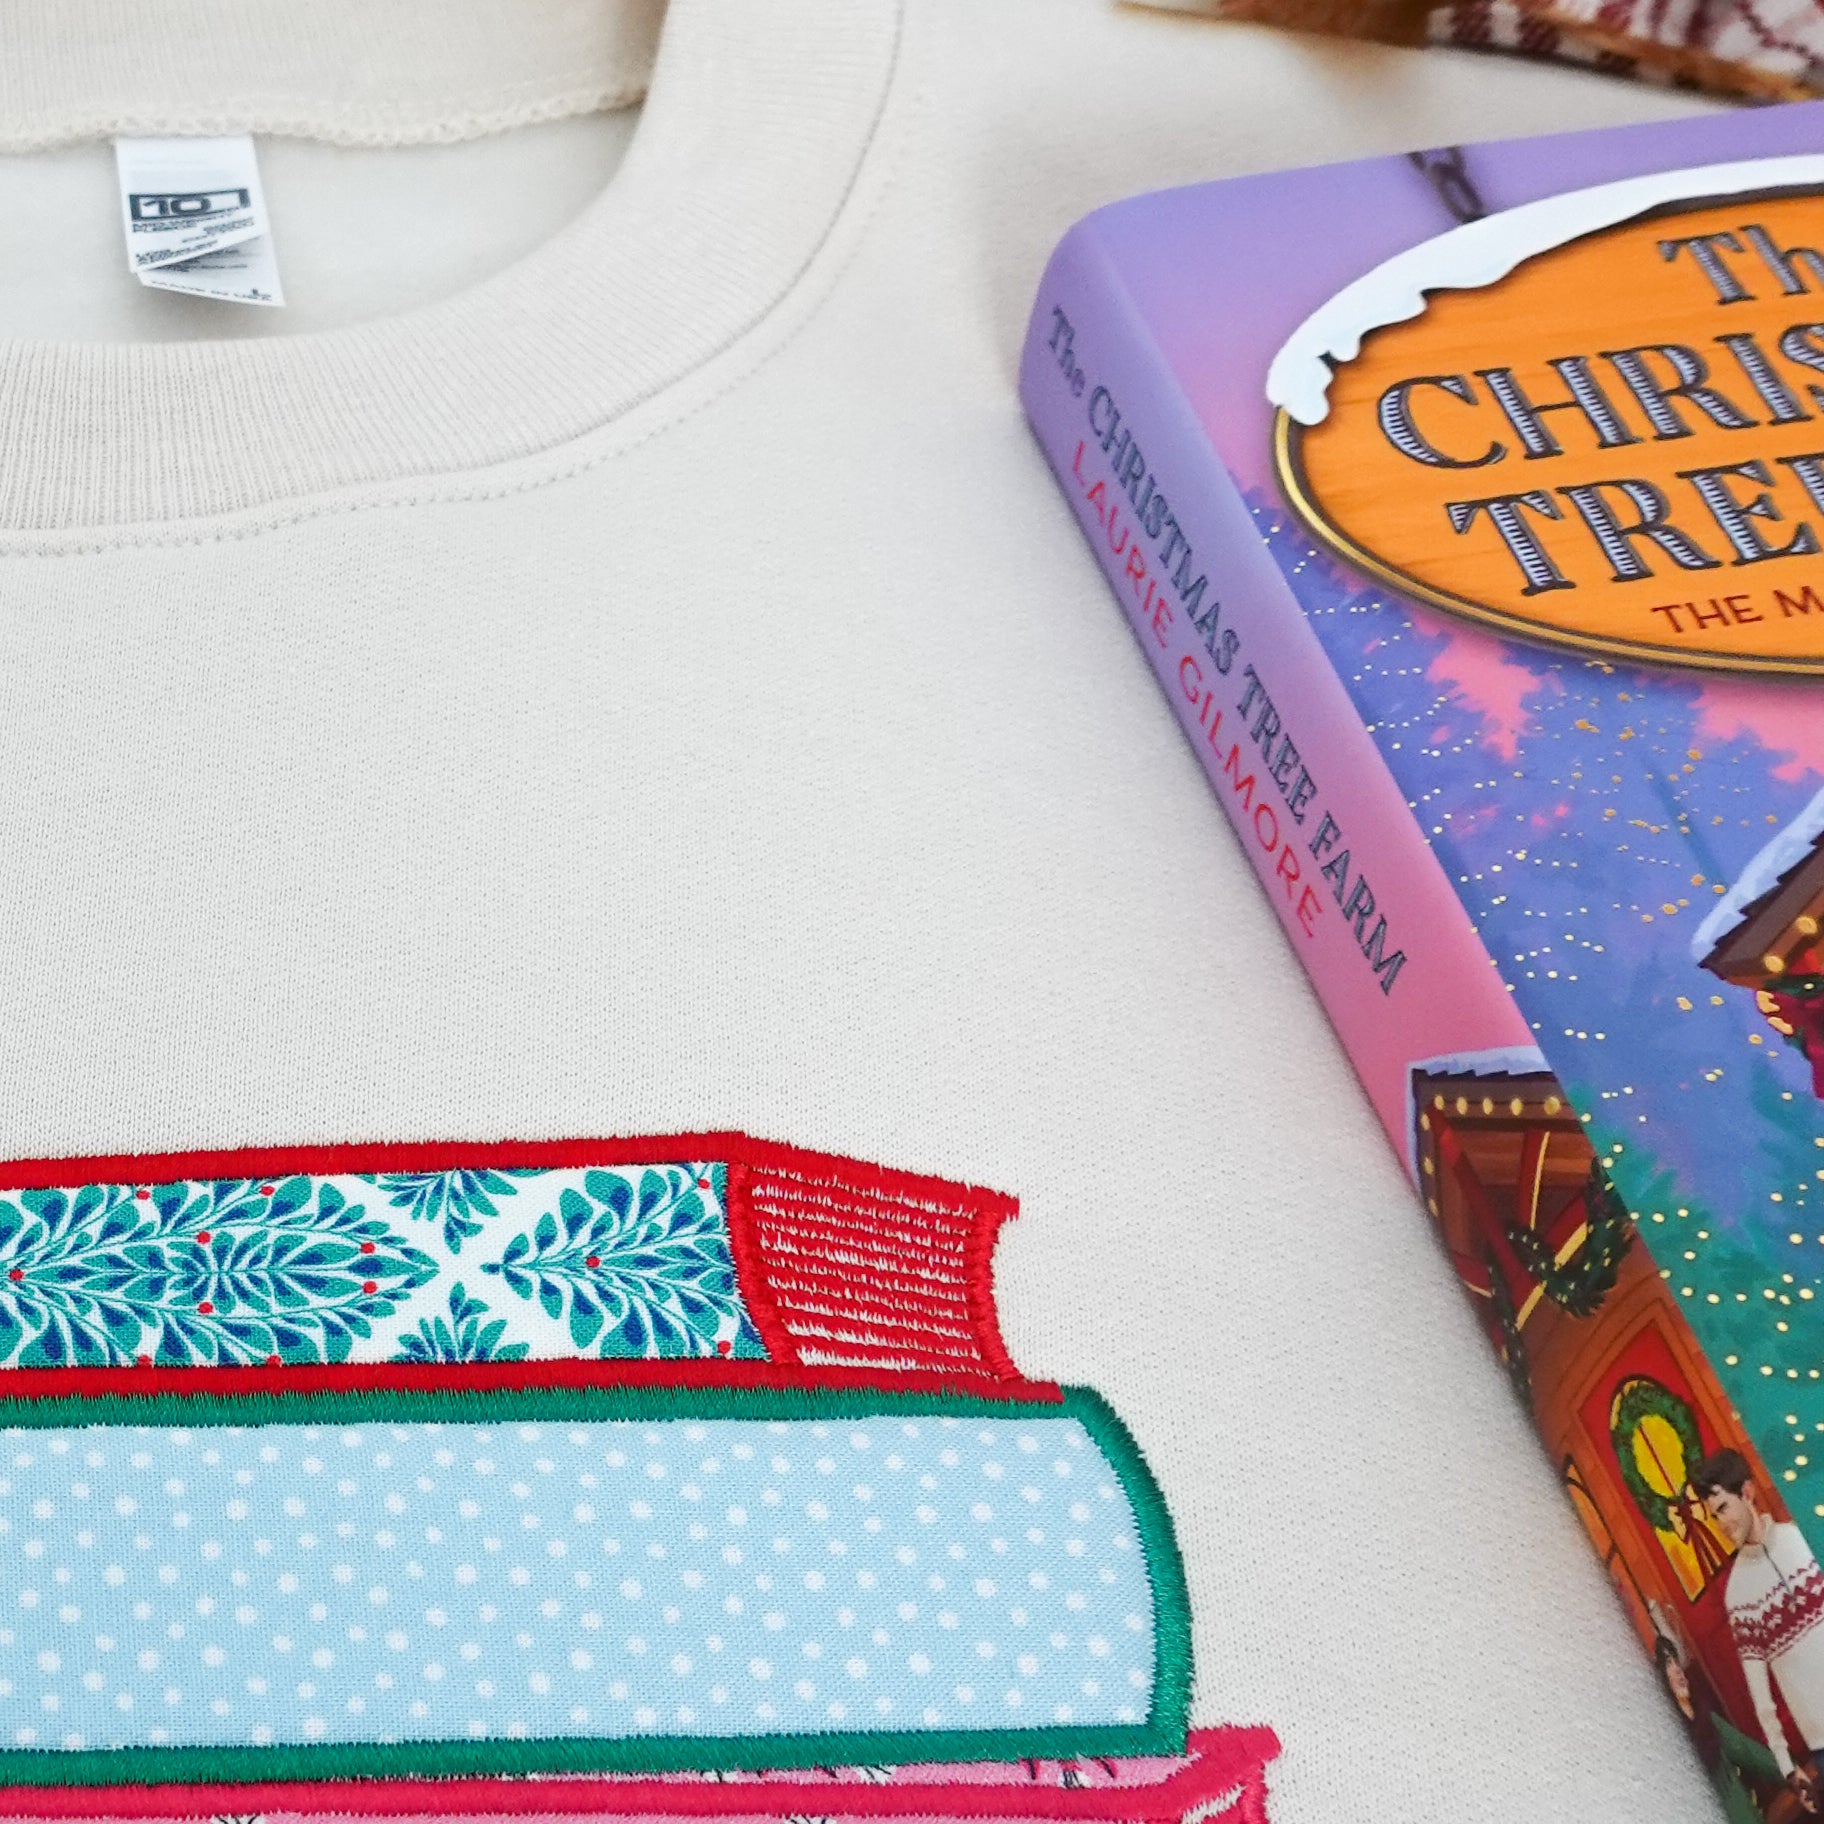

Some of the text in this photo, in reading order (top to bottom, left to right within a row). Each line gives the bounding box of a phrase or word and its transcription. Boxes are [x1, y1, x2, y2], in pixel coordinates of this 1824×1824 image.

[1049, 304, 1408, 997] The CHRISTMAS TREE FARM
[1073, 441, 1323, 939] LAURIE GILMORE
[1651, 594, 1764, 633] THE
